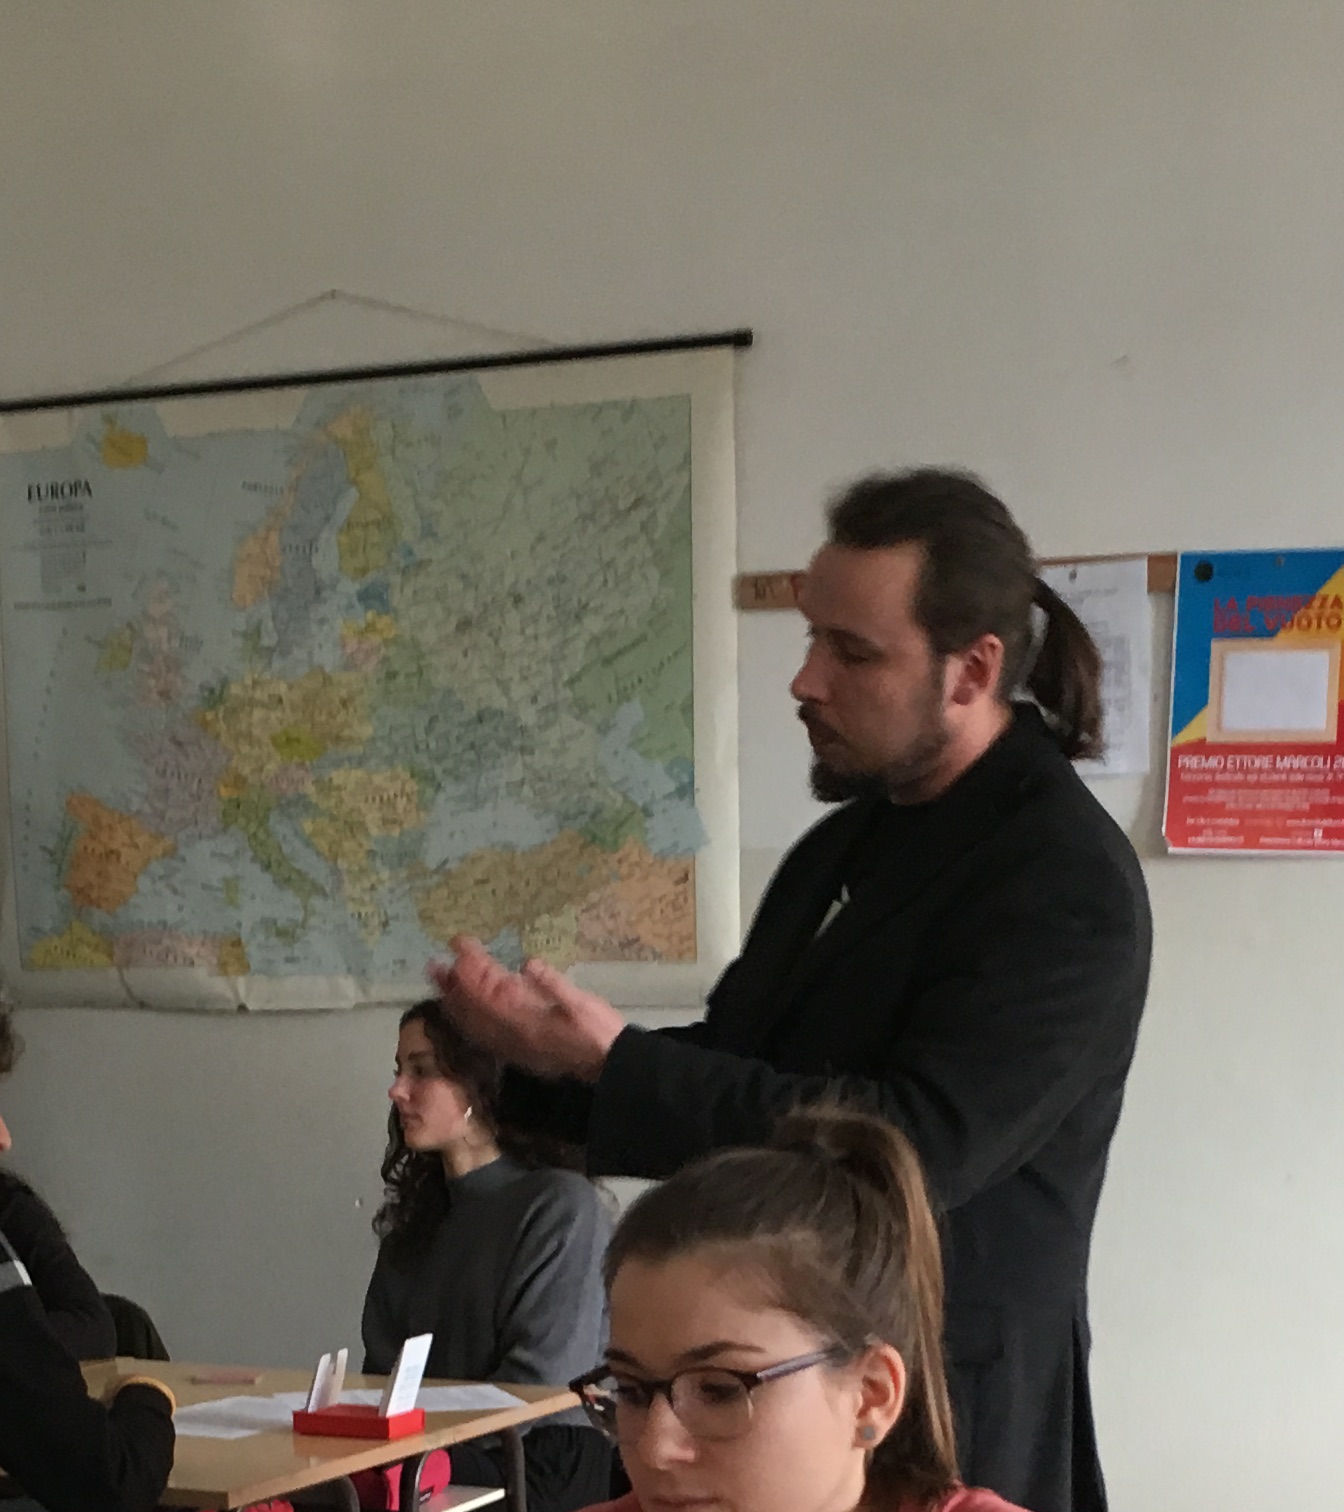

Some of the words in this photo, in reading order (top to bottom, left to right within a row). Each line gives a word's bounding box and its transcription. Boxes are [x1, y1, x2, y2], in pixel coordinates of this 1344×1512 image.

[27, 480, 93, 501] EUROPA
[1178, 754, 1224, 769] PREMIO
[1227, 754, 1273, 769] ETTORE
